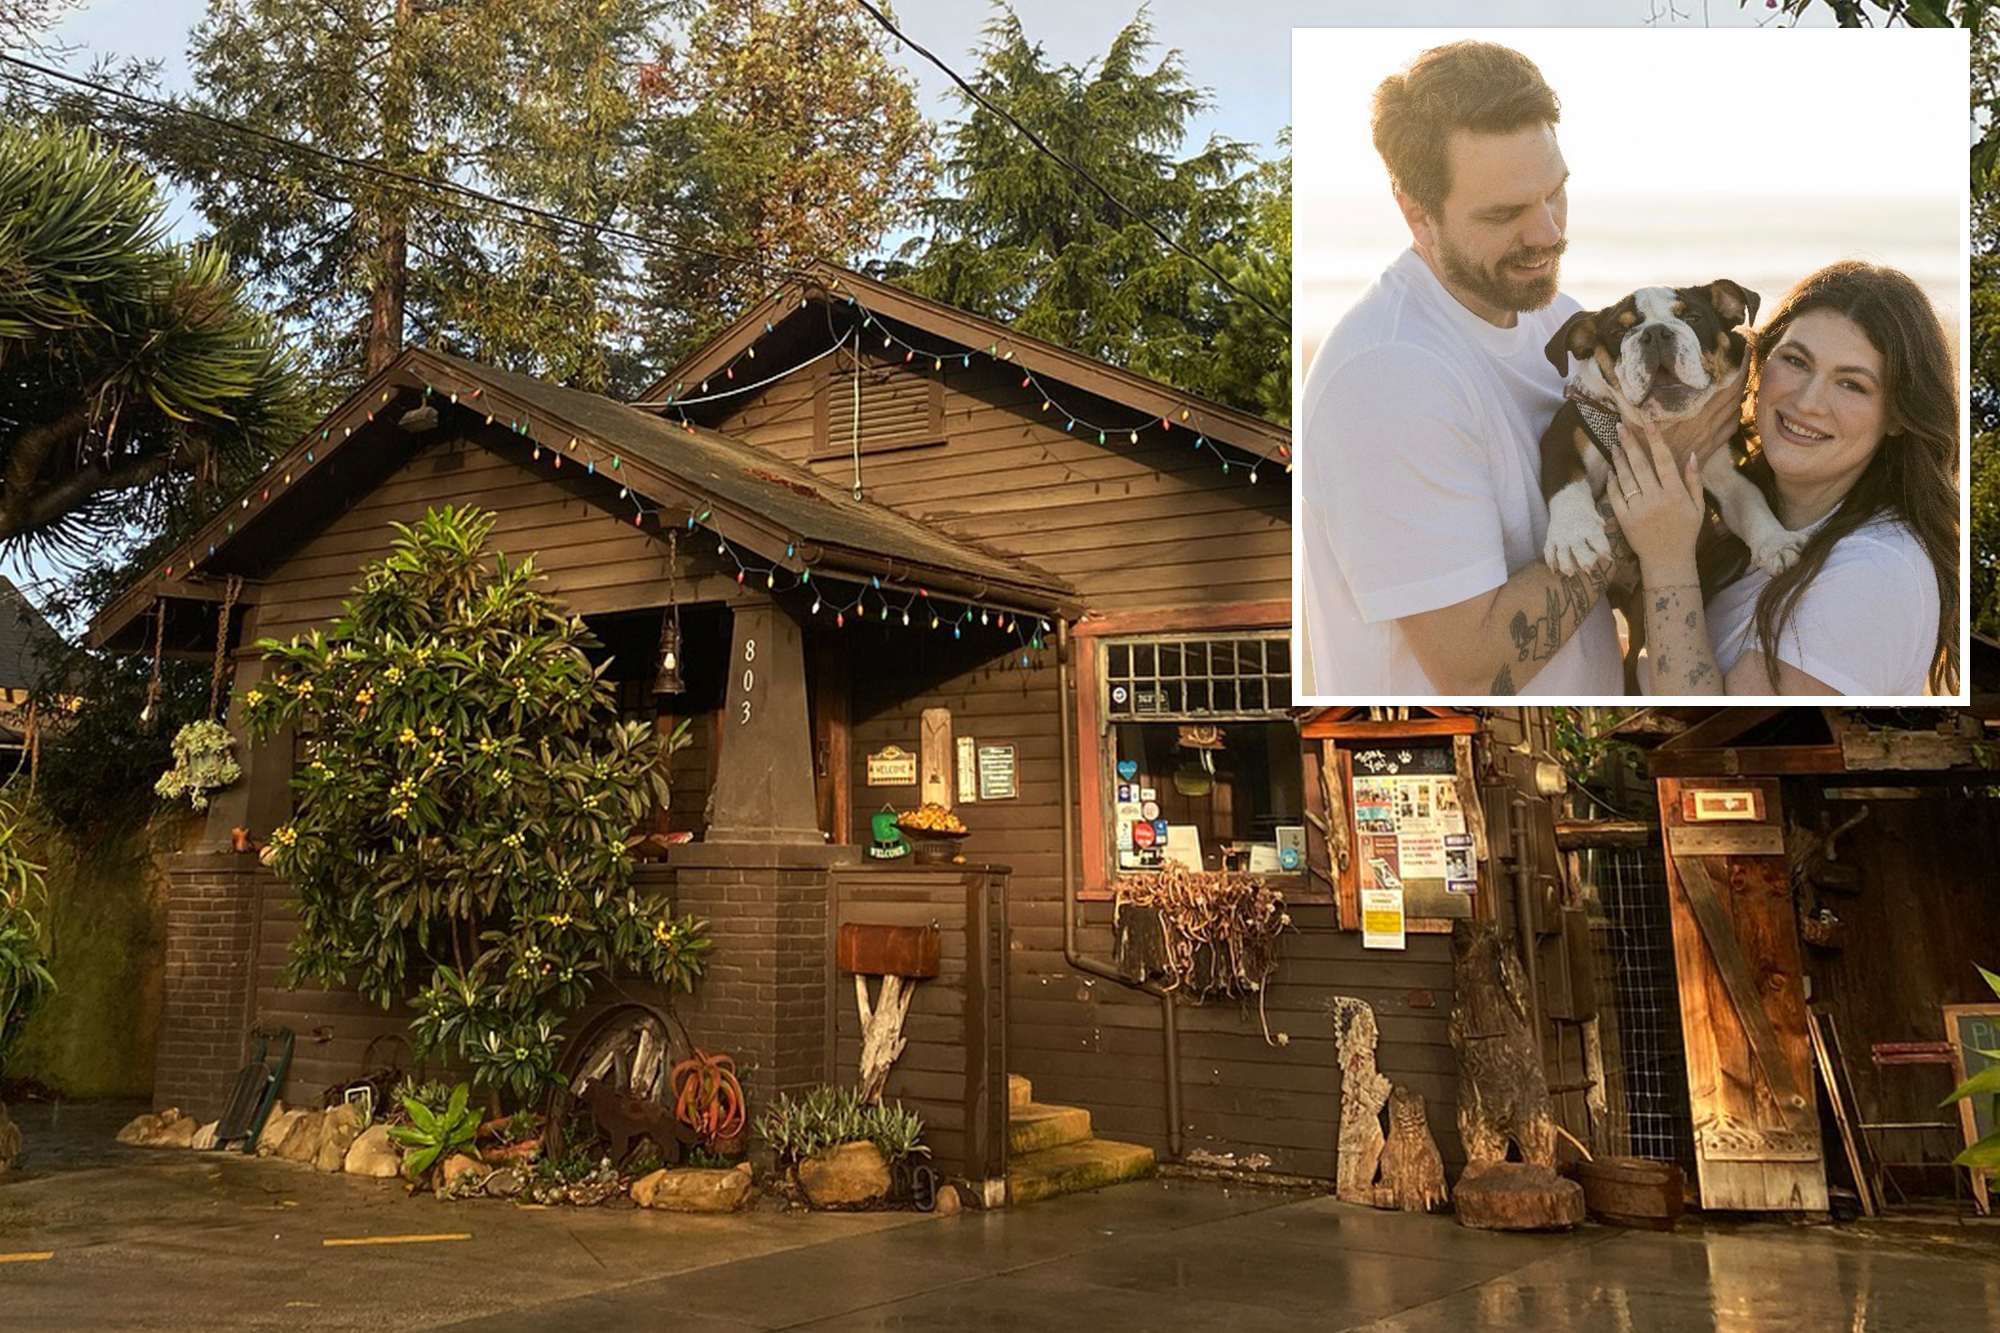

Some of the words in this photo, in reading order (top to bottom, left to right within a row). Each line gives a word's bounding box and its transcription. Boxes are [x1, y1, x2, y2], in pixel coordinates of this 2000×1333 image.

[741, 639, 755, 724] 803
[875, 765, 907, 775] WELCOME
[870, 845, 906, 859] WELCOME
